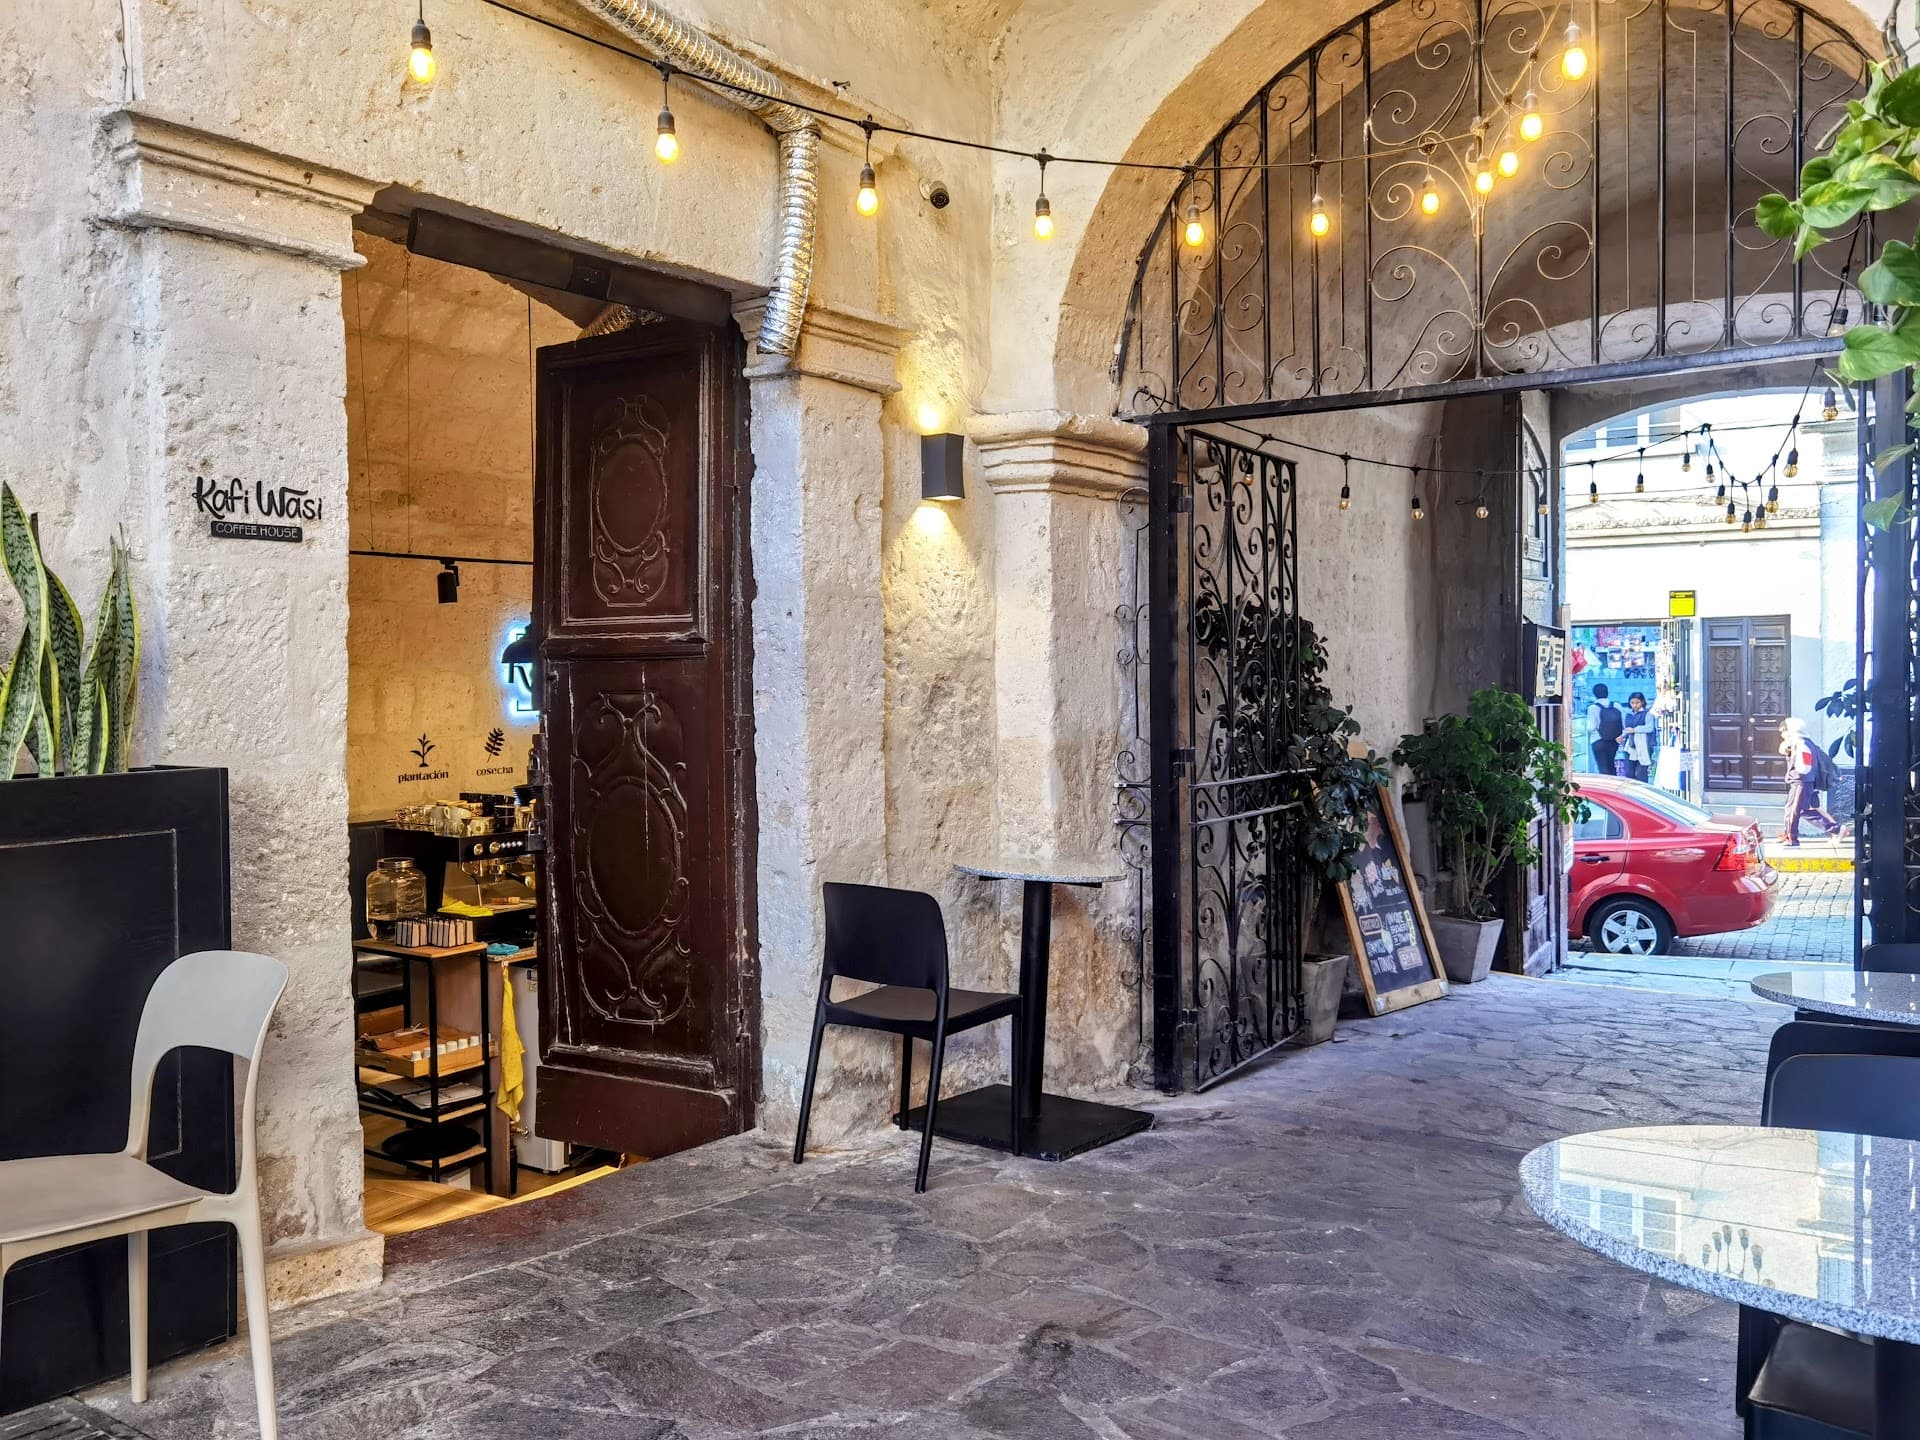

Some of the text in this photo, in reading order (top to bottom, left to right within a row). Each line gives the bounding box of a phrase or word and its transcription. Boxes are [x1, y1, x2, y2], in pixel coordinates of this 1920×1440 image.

[192, 476, 323, 520] Kafi Wasi
[215, 523, 298, 539] COFFEE HOUSE
[398, 770, 449, 784] plantación
[476, 766, 514, 777] cosecha
